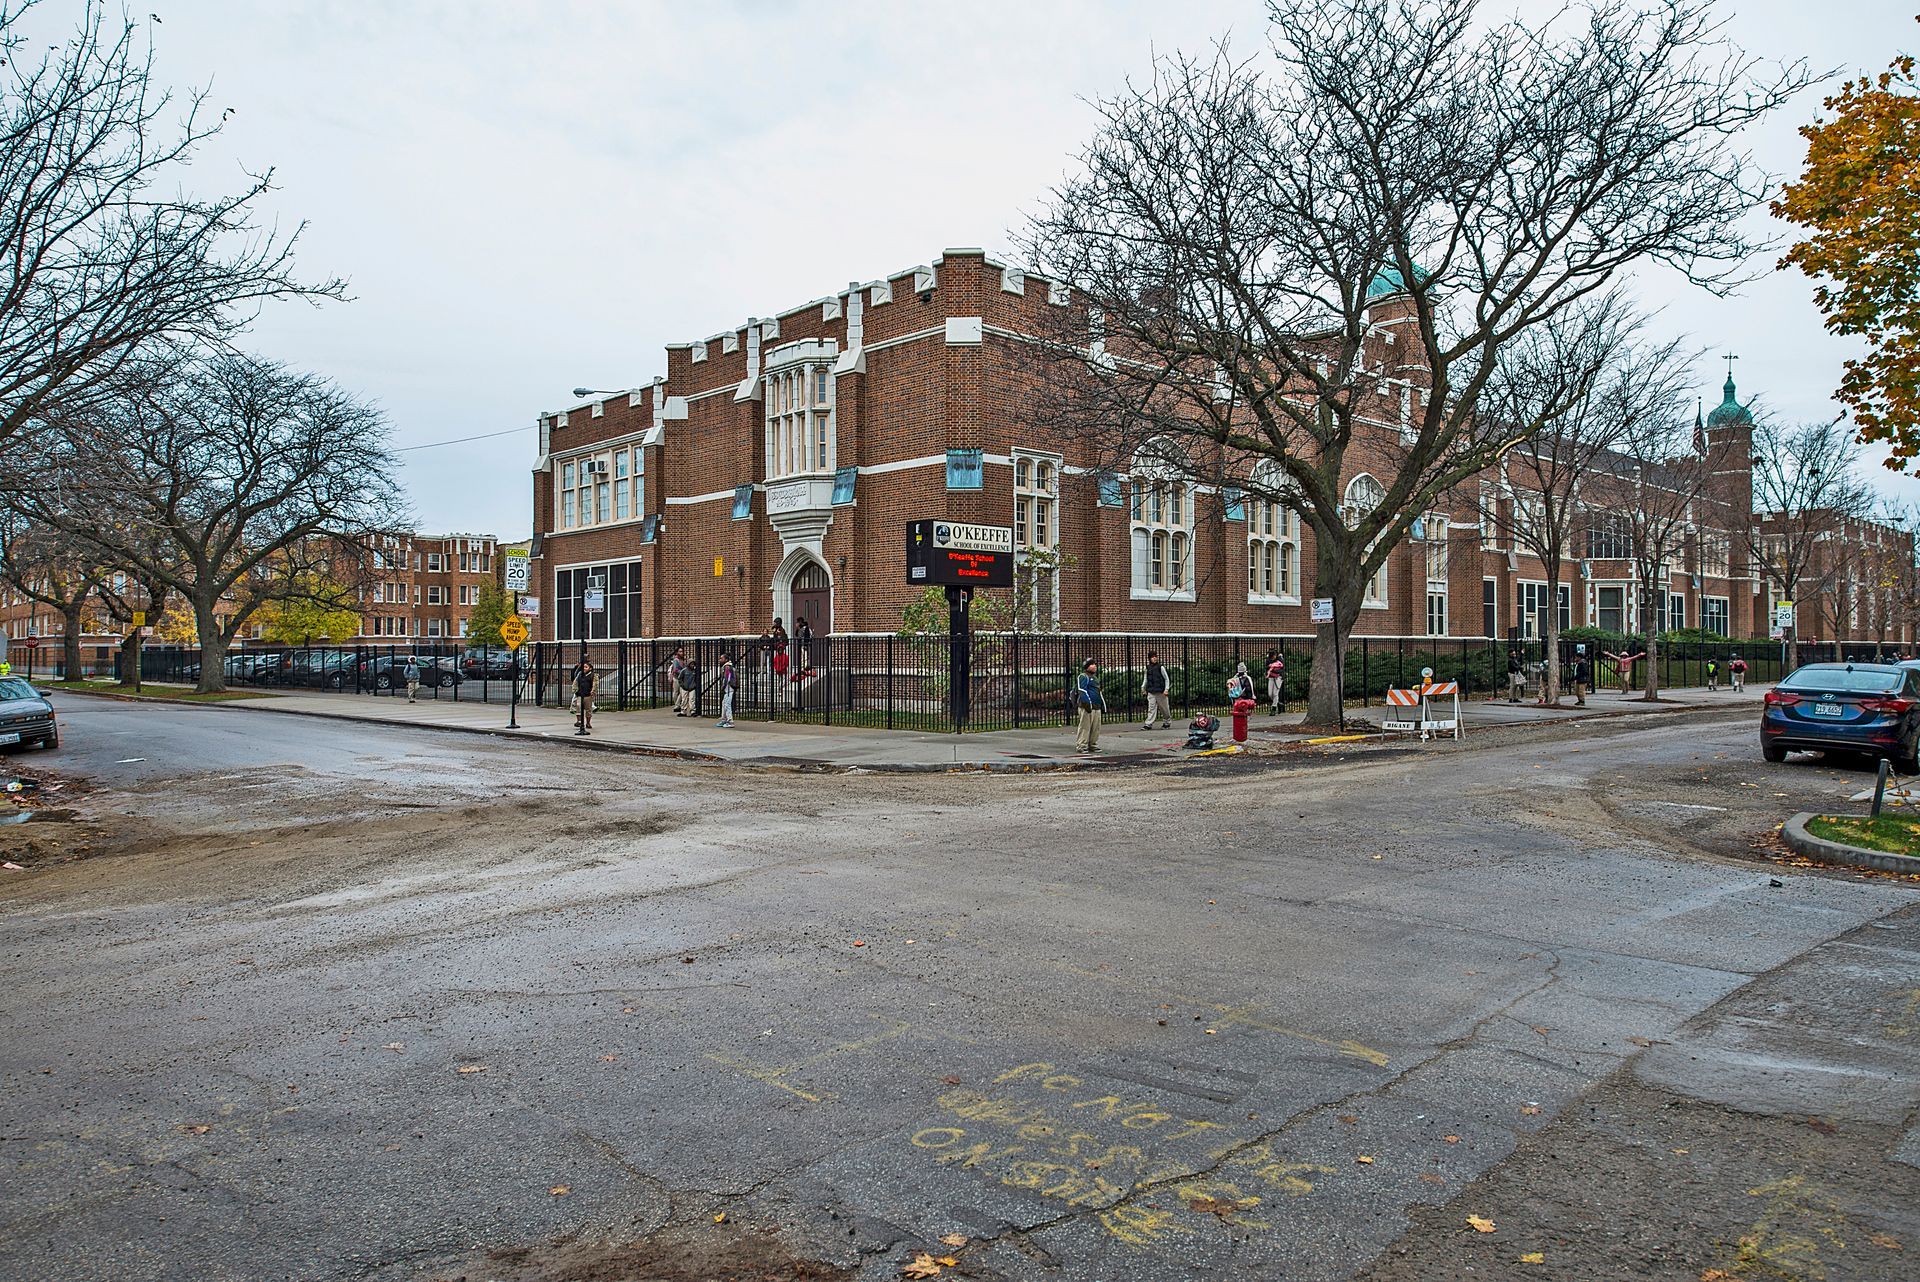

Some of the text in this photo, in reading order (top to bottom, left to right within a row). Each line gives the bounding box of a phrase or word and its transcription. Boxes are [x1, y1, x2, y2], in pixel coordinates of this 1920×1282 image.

[953, 525, 1009, 543] O'KEEFFE
[508, 568, 525, 579] 20
[1073, 1096, 1231, 1141] NOT
[910, 1127, 1026, 1168] ON
